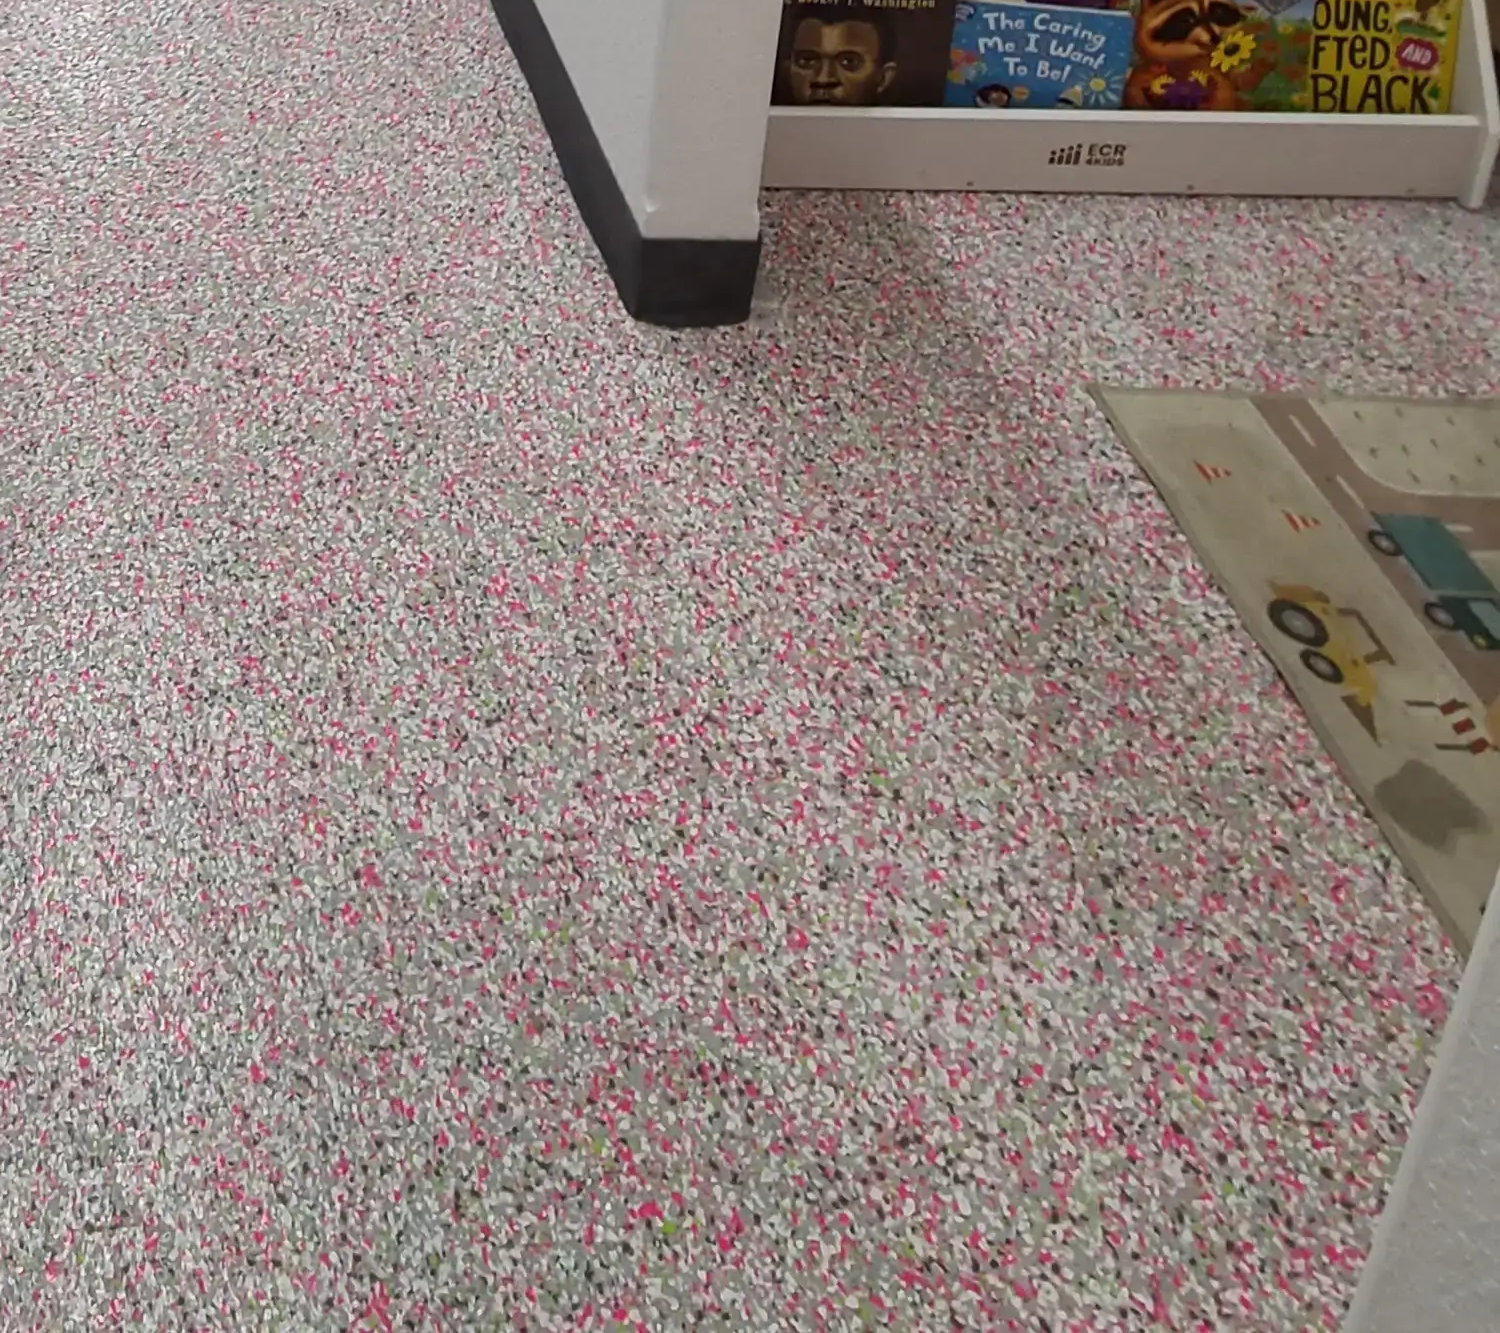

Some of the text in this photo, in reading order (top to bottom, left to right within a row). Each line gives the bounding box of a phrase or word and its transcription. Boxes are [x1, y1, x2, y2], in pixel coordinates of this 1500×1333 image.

[982, 12, 1107, 52] The Caring
[977, 33, 1106, 70] Me I Want
[1402, 43, 1432, 65] AND
[1003, 57, 1028, 76] To
[1310, 73, 1431, 113] BLACK
[1088, 143, 1126, 157] ECR
